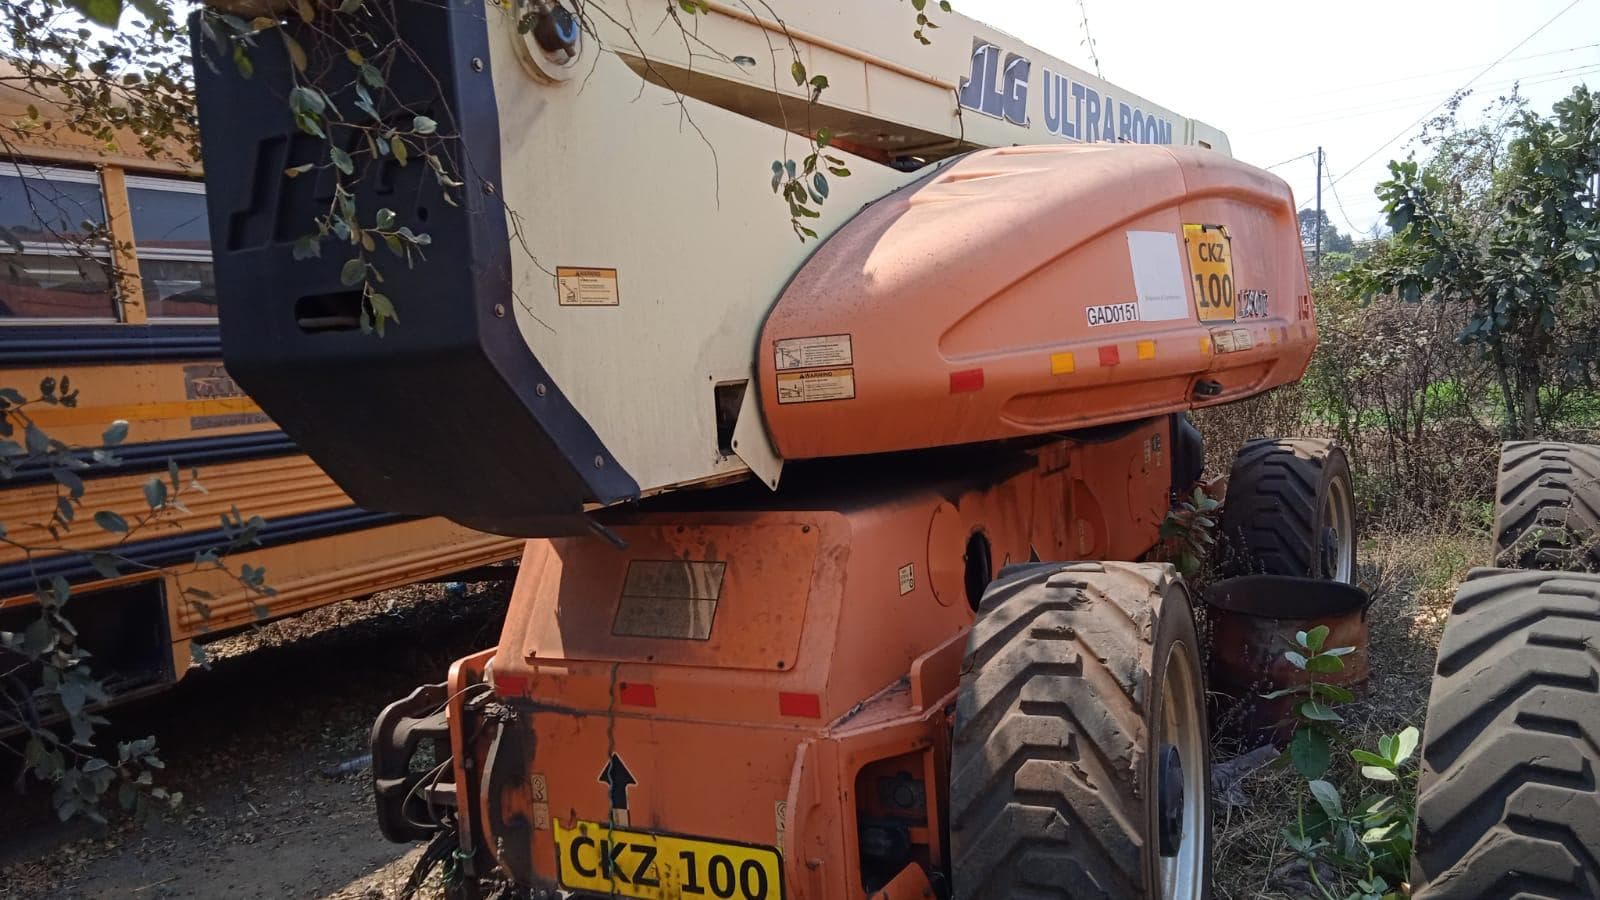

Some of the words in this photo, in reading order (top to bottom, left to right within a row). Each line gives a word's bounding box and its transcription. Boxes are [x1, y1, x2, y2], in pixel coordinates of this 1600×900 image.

[960, 37, 1031, 128] JLG
[1042, 68, 1116, 144] ULTRA
[1119, 101, 1172, 144] BOOM
[1199, 242, 1226, 263] CKZ
[1195, 273, 1233, 308] 100
[1087, 304, 1137, 326] GAD0151
[570, 836, 661, 887] CKZ
[679, 851, 769, 900] 100
